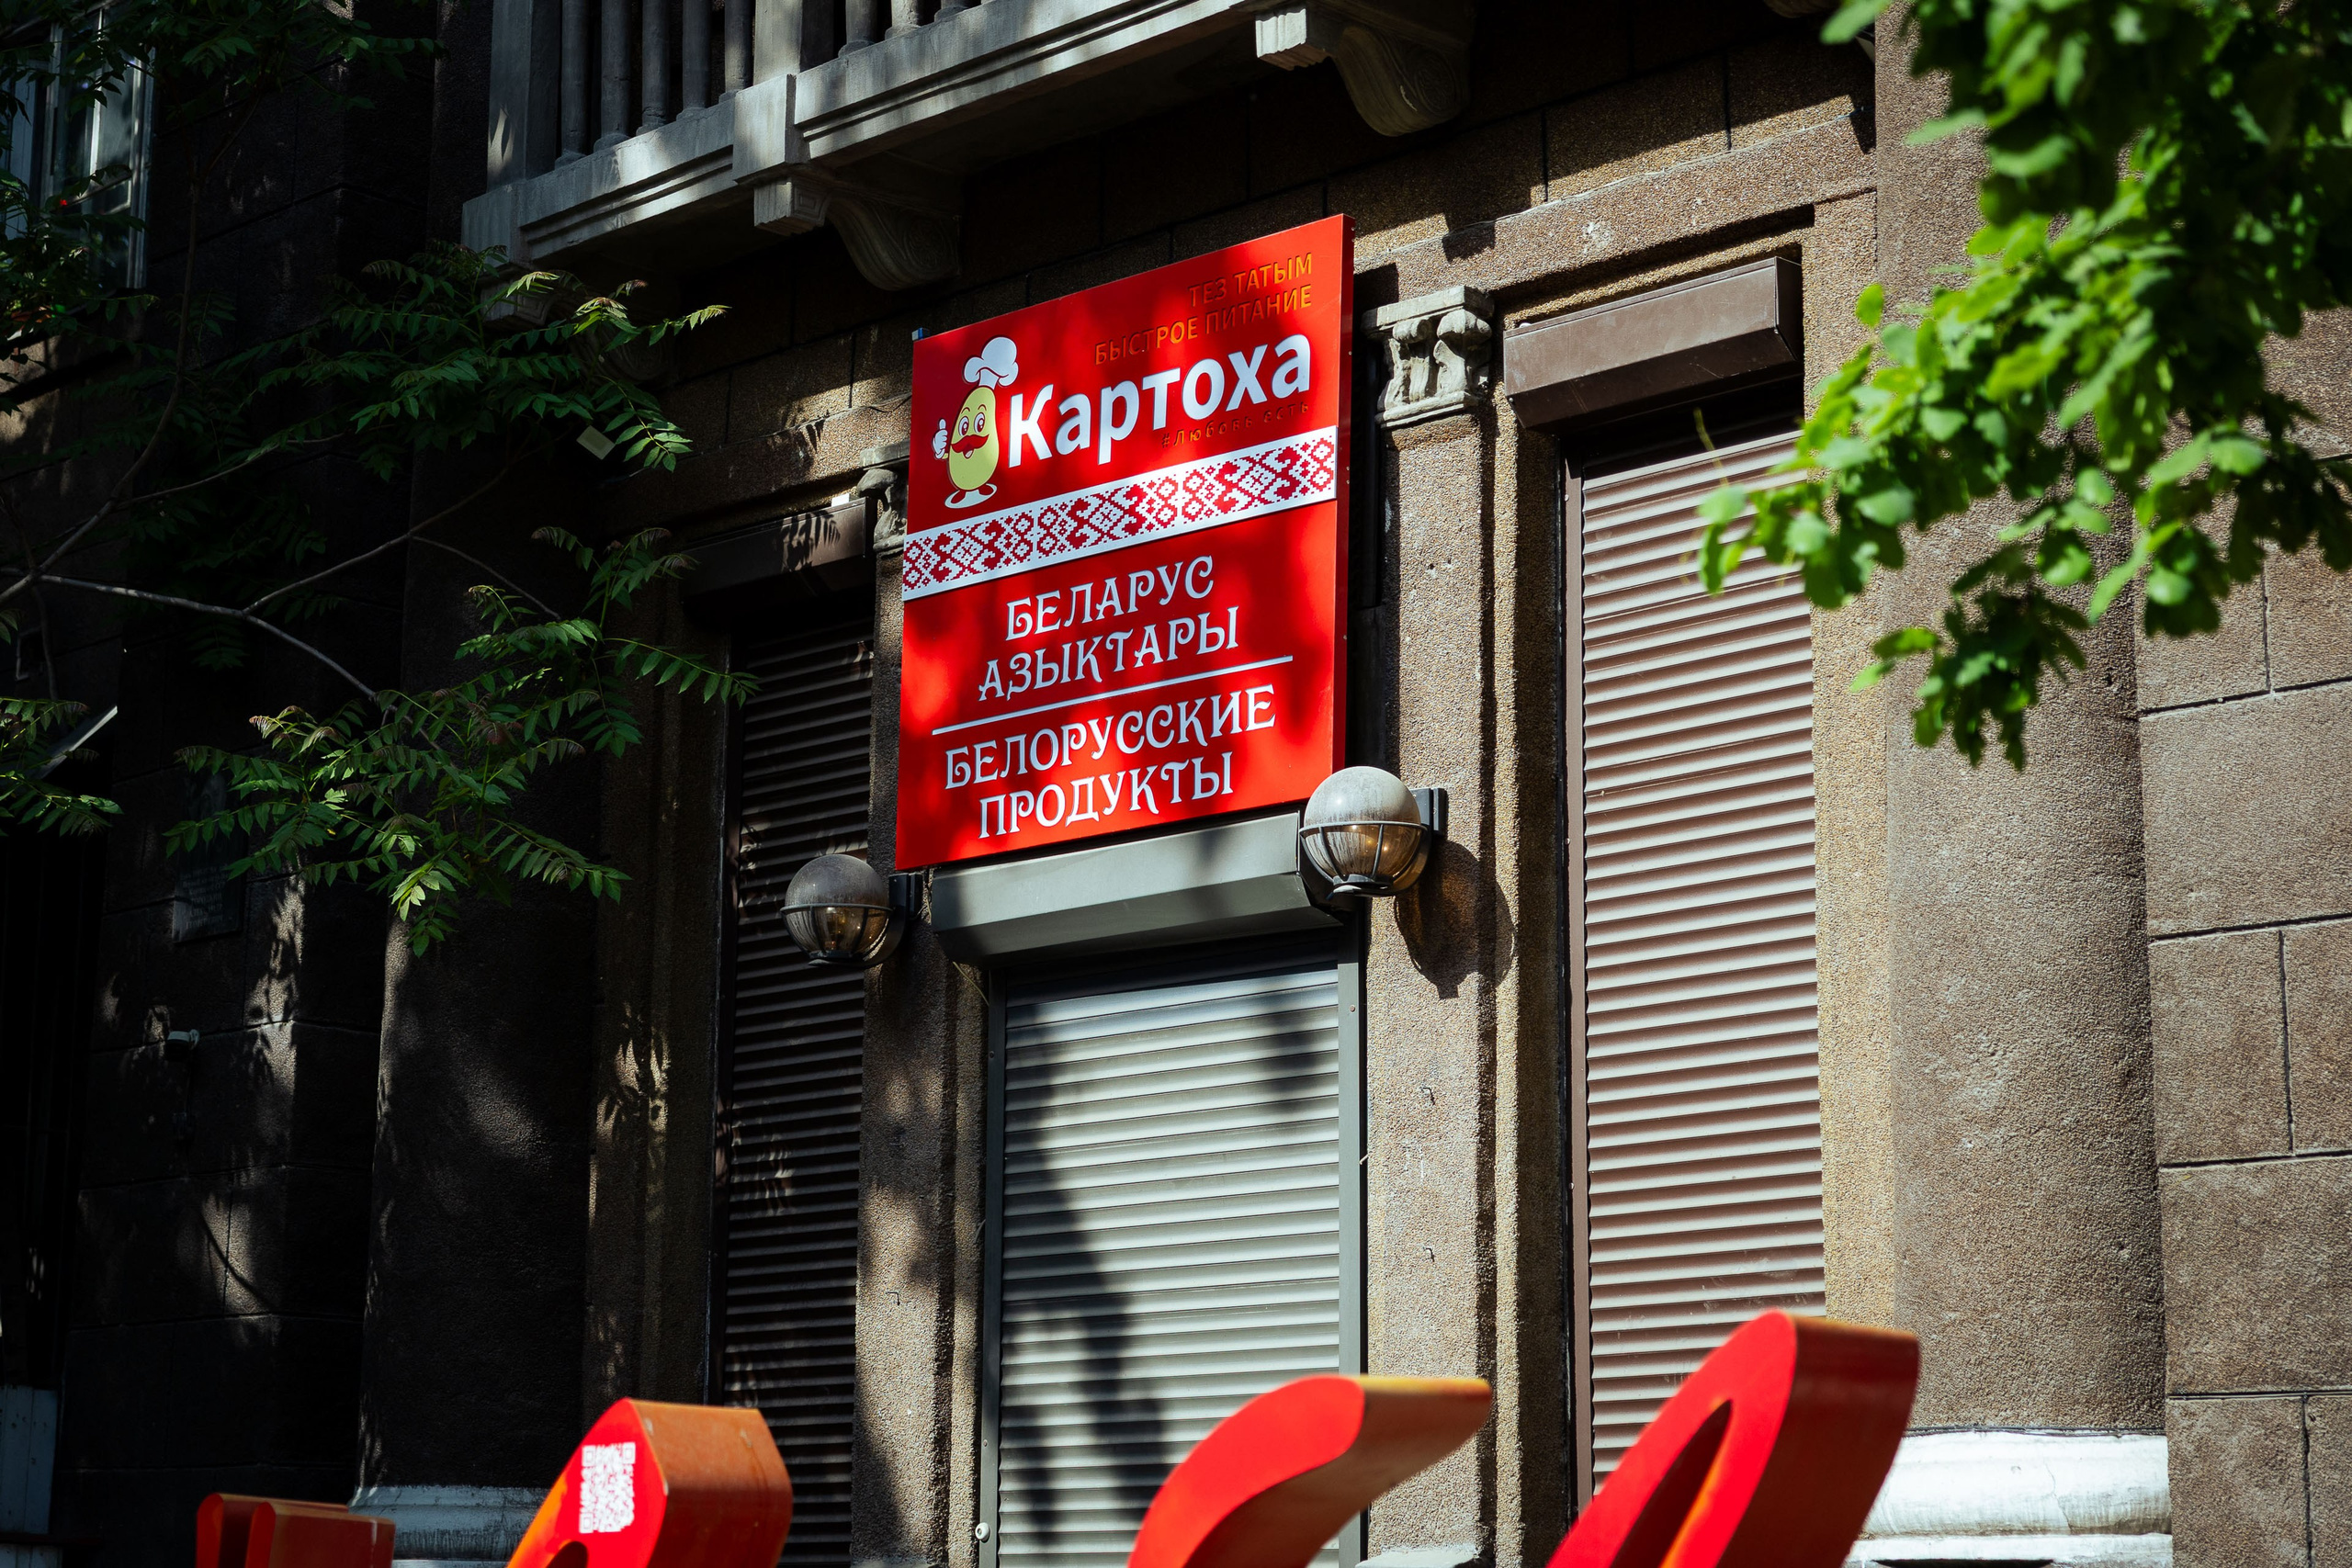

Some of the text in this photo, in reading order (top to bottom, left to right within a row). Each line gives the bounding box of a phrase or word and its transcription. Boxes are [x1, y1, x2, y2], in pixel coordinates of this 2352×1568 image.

[1188, 253, 1312, 308] ТЕЗ ТАТЫМ
[1094, 284, 1312, 366] БЫСТРОЕ ПИТАНИЕ
[1008, 334, 1311, 468] Картоха
[1264, 401, 1309, 423] есть
[1006, 555, 1214, 641] БЕЛАРУС
[978, 606, 1239, 701] АЗЫКТАРЫ
[944, 683, 1276, 790] БЕЛОРУССКИЕ
[978, 751, 1233, 839] ПРОДУКТЫ
